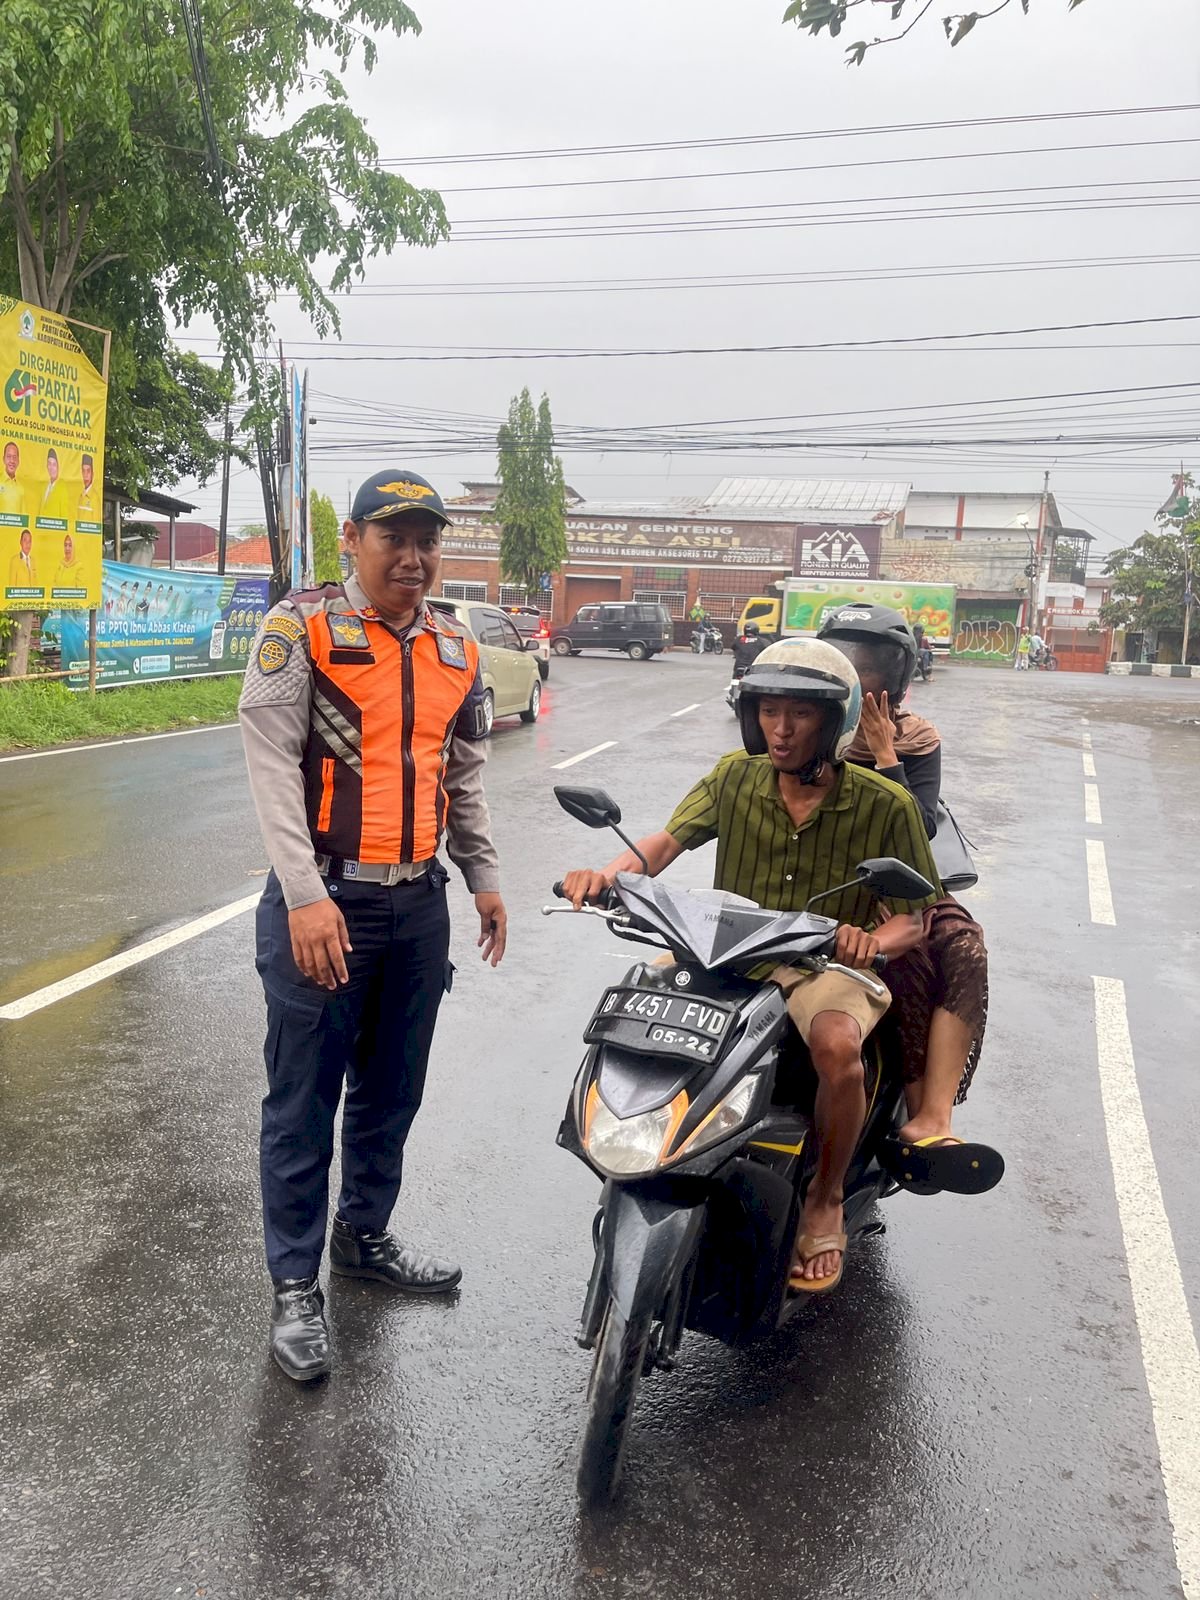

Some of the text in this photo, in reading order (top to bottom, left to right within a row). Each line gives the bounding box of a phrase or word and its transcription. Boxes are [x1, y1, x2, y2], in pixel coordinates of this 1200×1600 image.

[20, 351, 78, 382] DIRGAHAYU
[38, 375, 80, 405] PARTAI
[38, 398, 91, 429] GOLKAR
[0, 428, 24, 440] OLKAR
[29, 420, 46, 431] SOLID
[46, 425, 75, 438] INDONESIA
[638, 524, 734, 535] GENTENG
[668, 535, 740, 548] ASLI
[801, 533, 870, 562] KIA
[575, 545, 599, 554] SOKKA
[602, 547, 619, 555] ASLI
[621, 548, 655, 557] KEBUMEN
[108, 620, 128, 636] PPTQ
[130, 620, 147, 634] Ibnu
[148, 620, 171, 634] Abbas
[172, 620, 196, 634] Klaten
[704, 912, 734, 927] YAMAHA
[603, 992, 728, 1036] B 4451 FVD
[748, 1009, 778, 1042] YAMAHA
